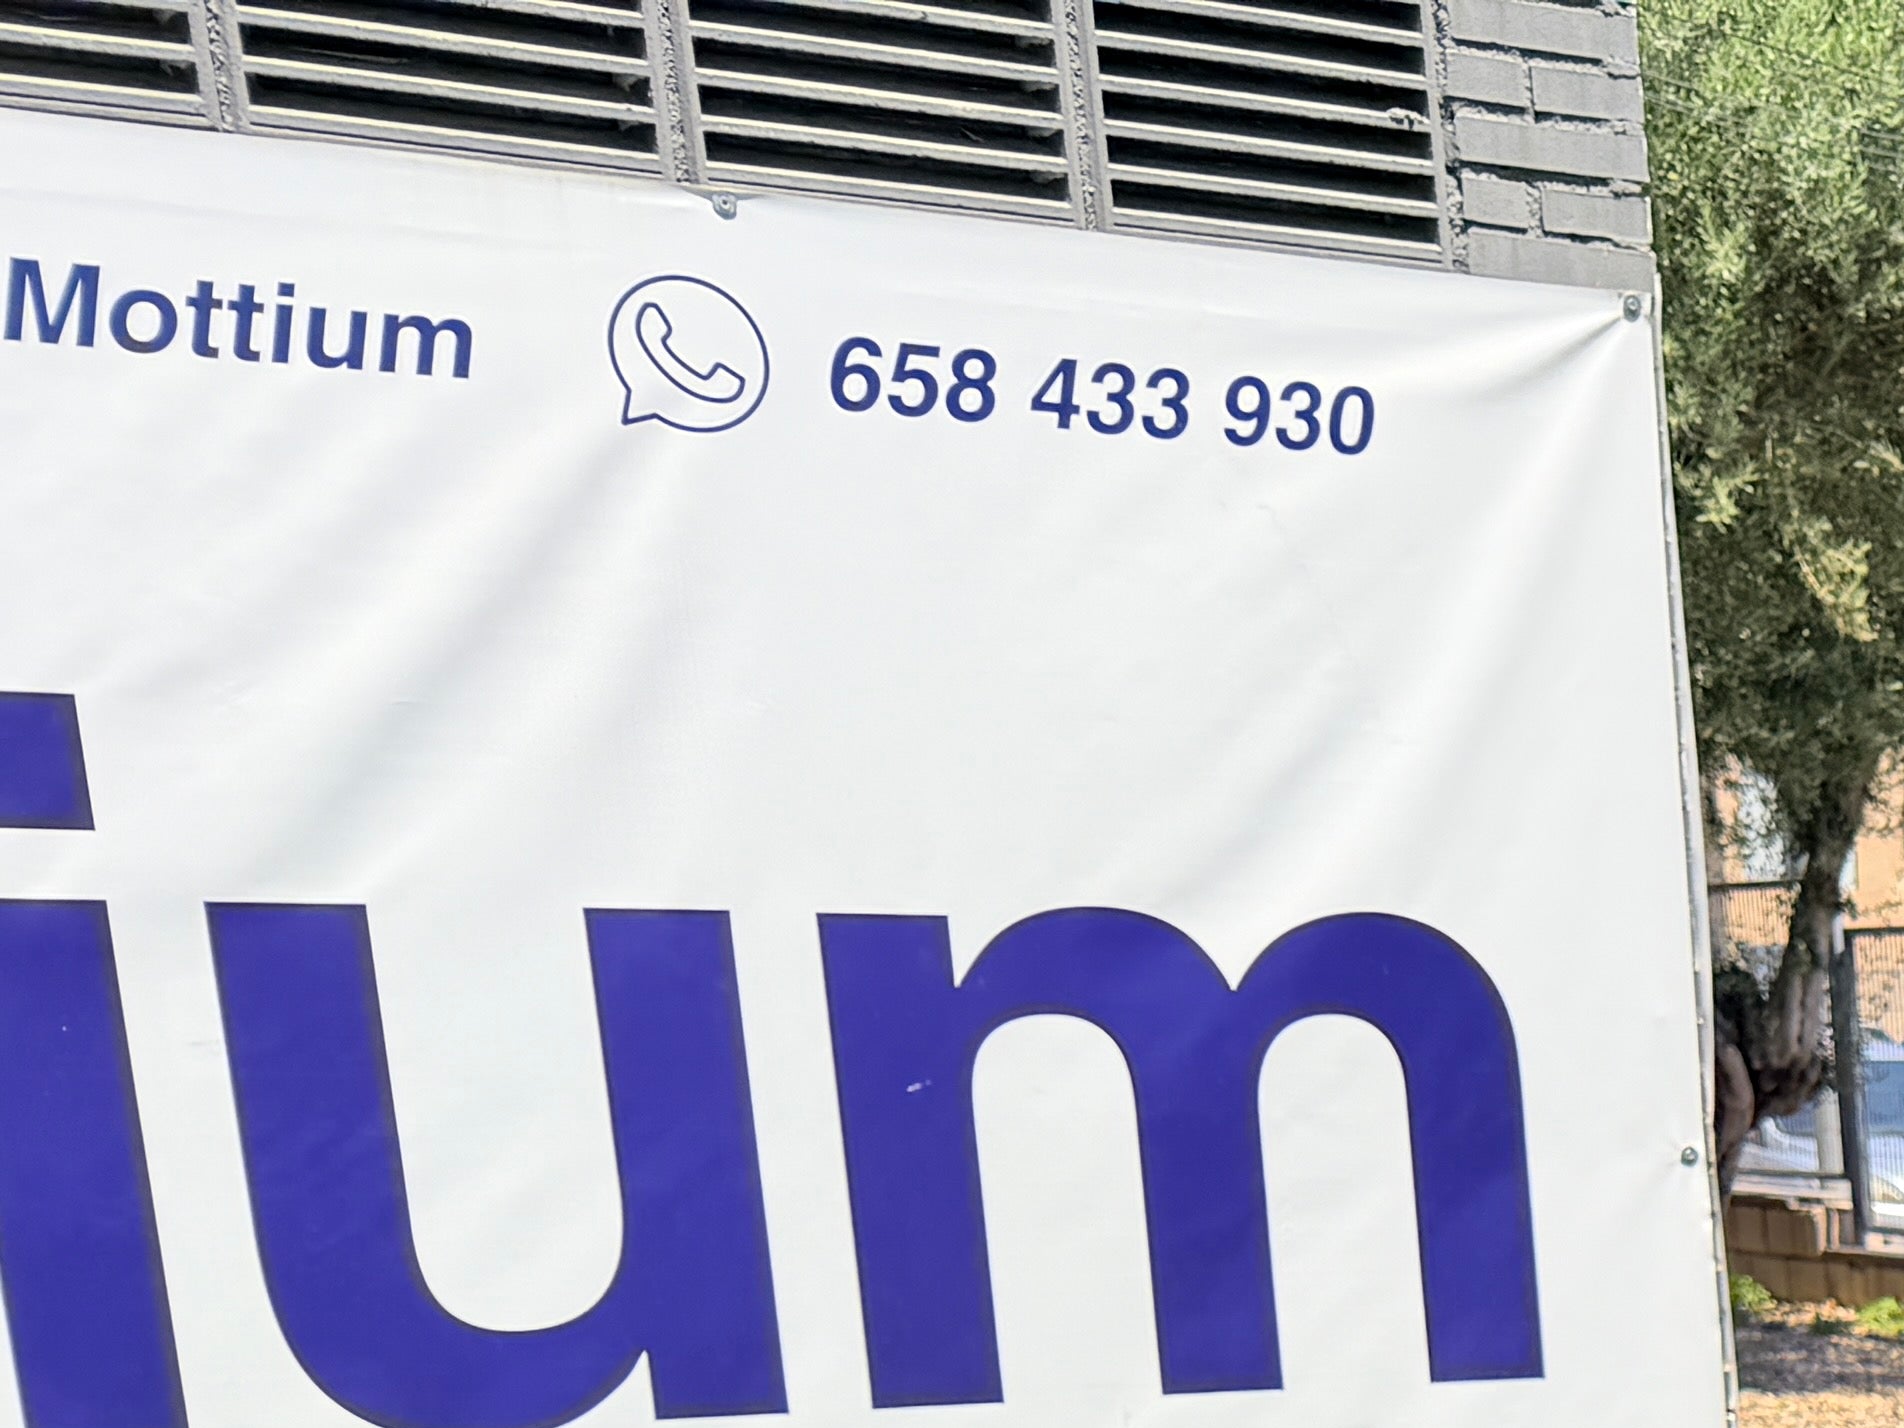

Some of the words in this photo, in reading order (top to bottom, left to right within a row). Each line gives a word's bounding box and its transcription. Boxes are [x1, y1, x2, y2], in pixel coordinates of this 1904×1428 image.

[4, 257, 472, 378] Mottium
[830, 337, 997, 422] 658
[1030, 358, 1190, 440] 433
[1223, 376, 1376, 455] 930
